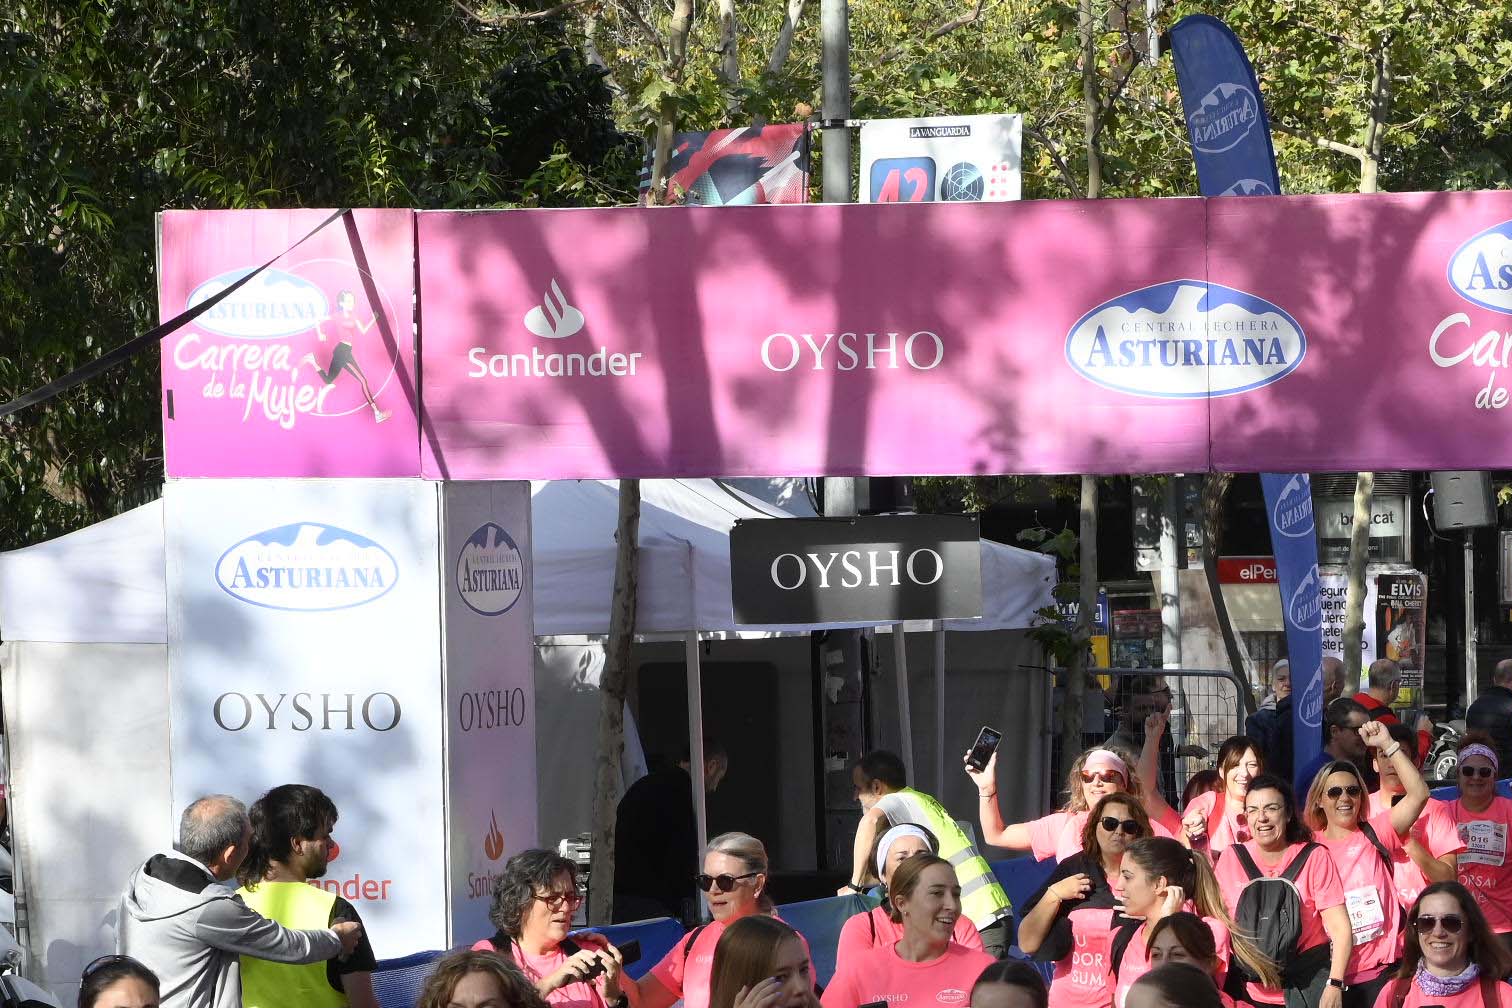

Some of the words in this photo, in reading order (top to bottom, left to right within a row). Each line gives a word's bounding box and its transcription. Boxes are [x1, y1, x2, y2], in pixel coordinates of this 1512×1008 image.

[920, 126, 971, 137] VANGUARDIA
[1119, 319, 1196, 332] CENTRAL
[1203, 318, 1280, 331] LECHERA
[174, 333, 291, 371] Carrera
[468, 347, 642, 378] Santander
[760, 331, 945, 373] OYSHO
[1083, 324, 1288, 367] ASTURIANA
[203, 373, 224, 398] de
[229, 374, 246, 398] la
[242, 367, 337, 430] Mujer
[1475, 378, 1509, 409] de
[229, 556, 385, 589] ASTURIANA
[462, 559, 521, 593] ASTURIANA
[771, 547, 944, 590] OYSHO
[1391, 584, 1422, 596] ELVIS
[213, 691, 402, 731] OYSHO
[459, 687, 525, 732] OYSHO
[872, 993, 909, 1003] OYSHO
